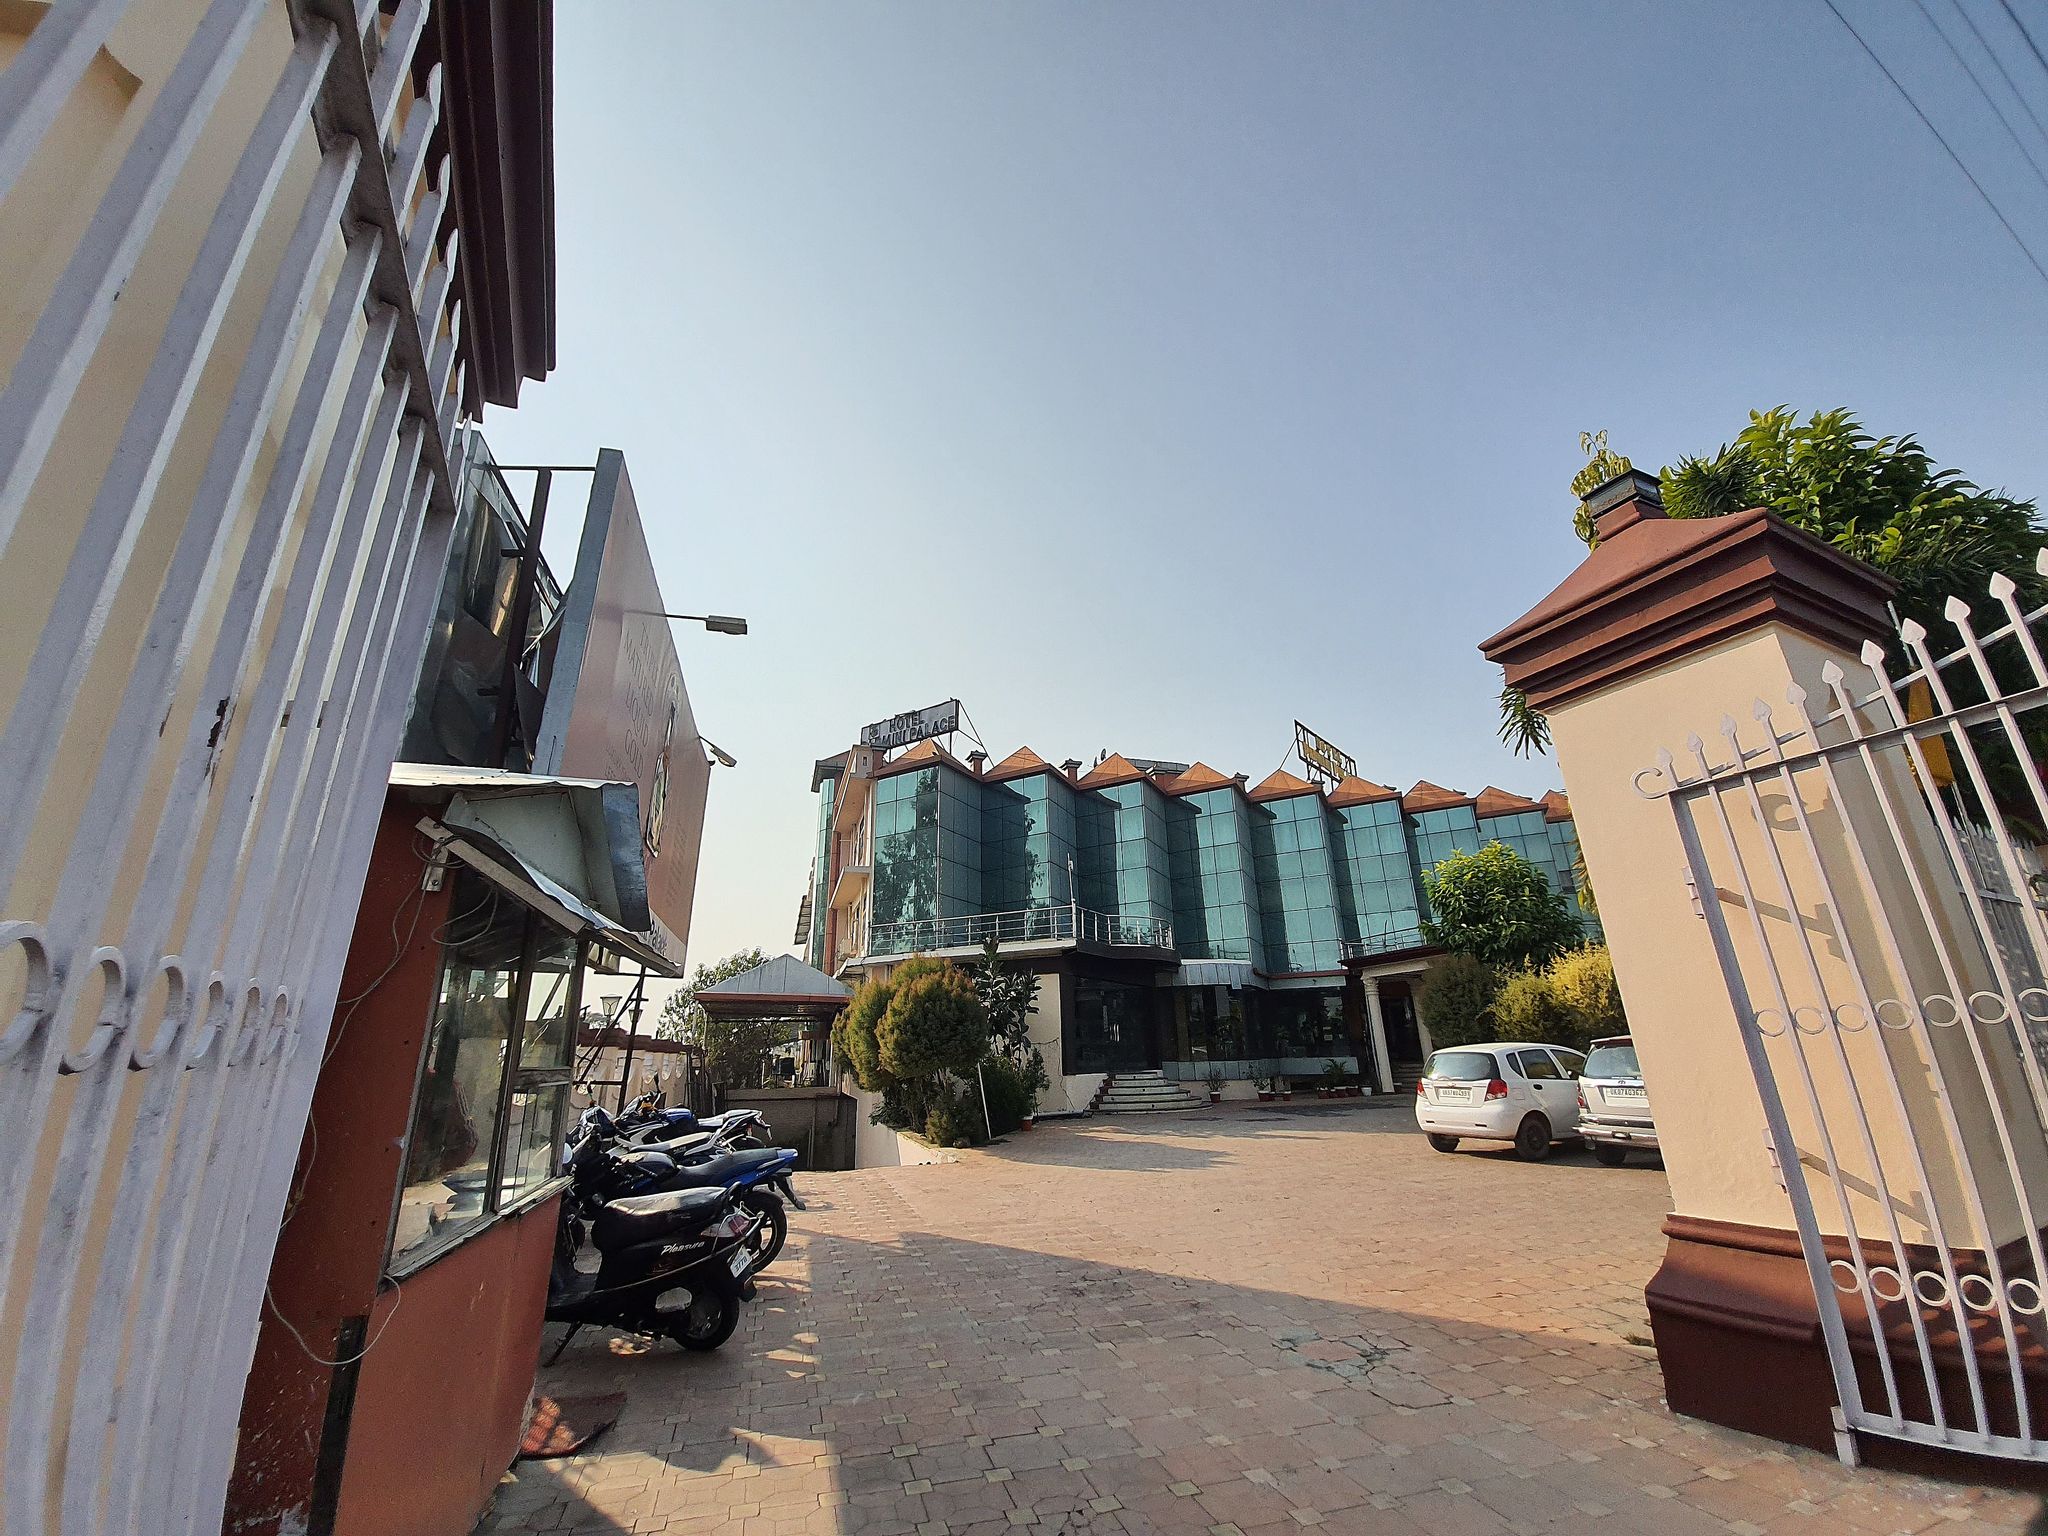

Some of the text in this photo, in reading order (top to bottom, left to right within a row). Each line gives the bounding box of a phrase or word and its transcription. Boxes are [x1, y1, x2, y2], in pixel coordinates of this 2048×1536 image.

[624, 629, 653, 717] MATURED
[625, 683, 649, 748] LIQUID
[889, 711, 925, 733] HOTEL
[910, 715, 956, 741] PALACE
[660, 1241, 705, 1256] Pleasure
